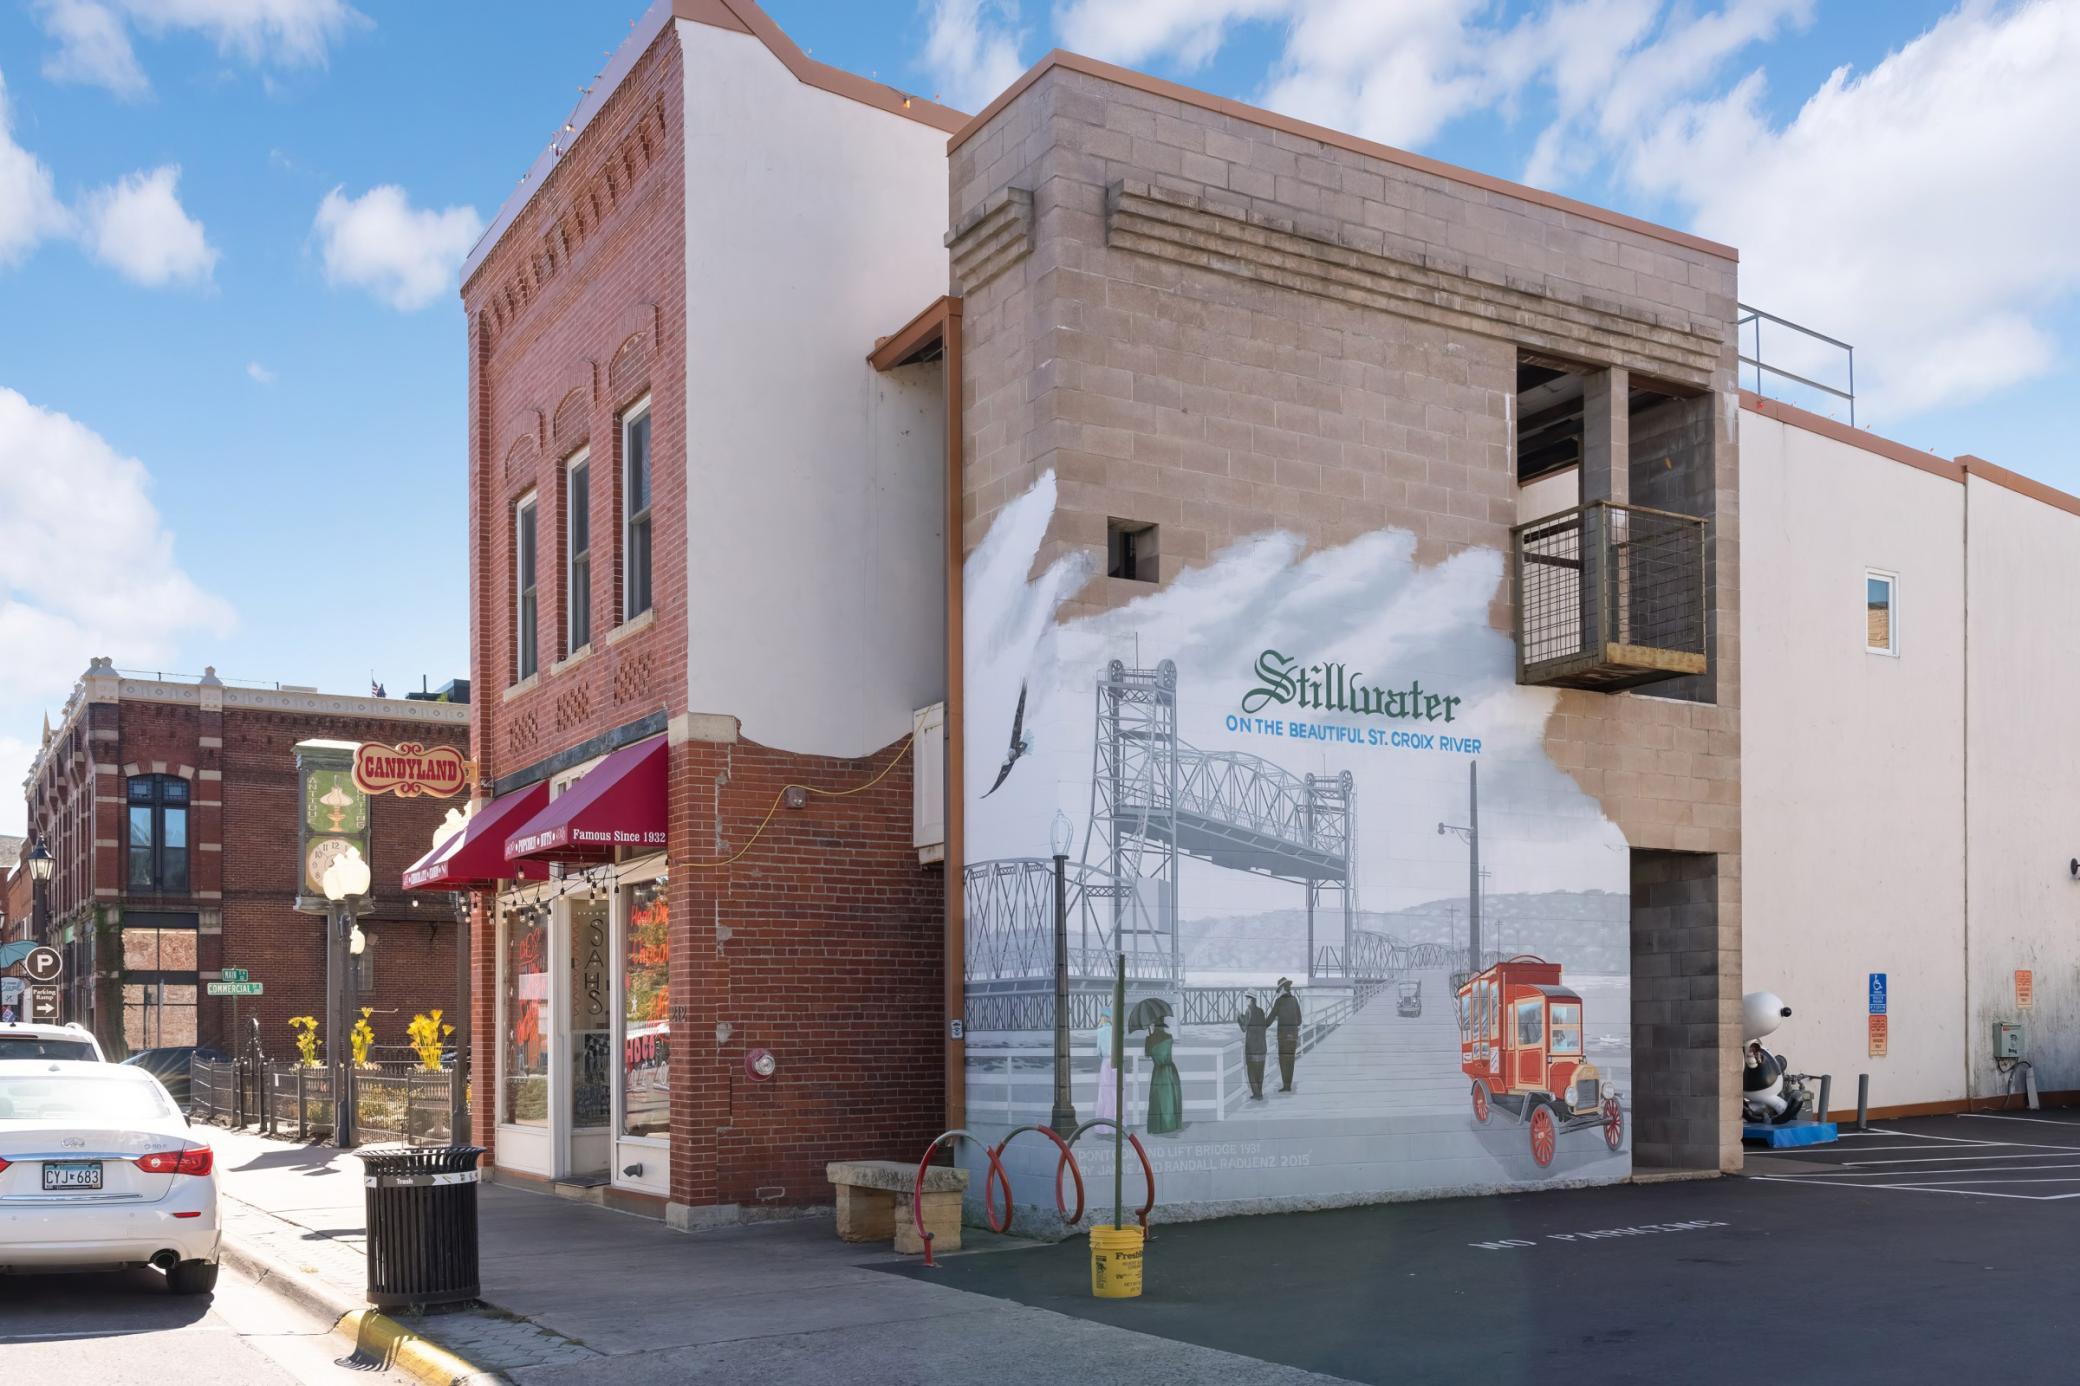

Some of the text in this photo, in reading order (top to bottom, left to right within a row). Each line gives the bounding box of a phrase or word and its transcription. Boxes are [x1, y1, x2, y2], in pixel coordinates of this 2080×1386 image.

[1241, 649, 1461, 723] Stillwater
[1225, 714, 1482, 754] ON THE BEAUTIFUL ST. CROIX RIVER
[365, 756, 457, 782] CANDYLAND
[573, 828, 611, 841] Famous
[614, 830, 640, 842] Since
[643, 831, 666, 843] 1932
[37, 954, 54, 973] P
[208, 984, 252, 993] COMMERCIAL
[1167, 1144, 1192, 1158] LIFT
[1194, 1142, 1237, 1157] BRIDGE
[1164, 1158, 1218, 1172] RANDALL
[1280, 1154, 1310, 1167] 2015
[46, 1170, 99, 1184] CYJ 683
